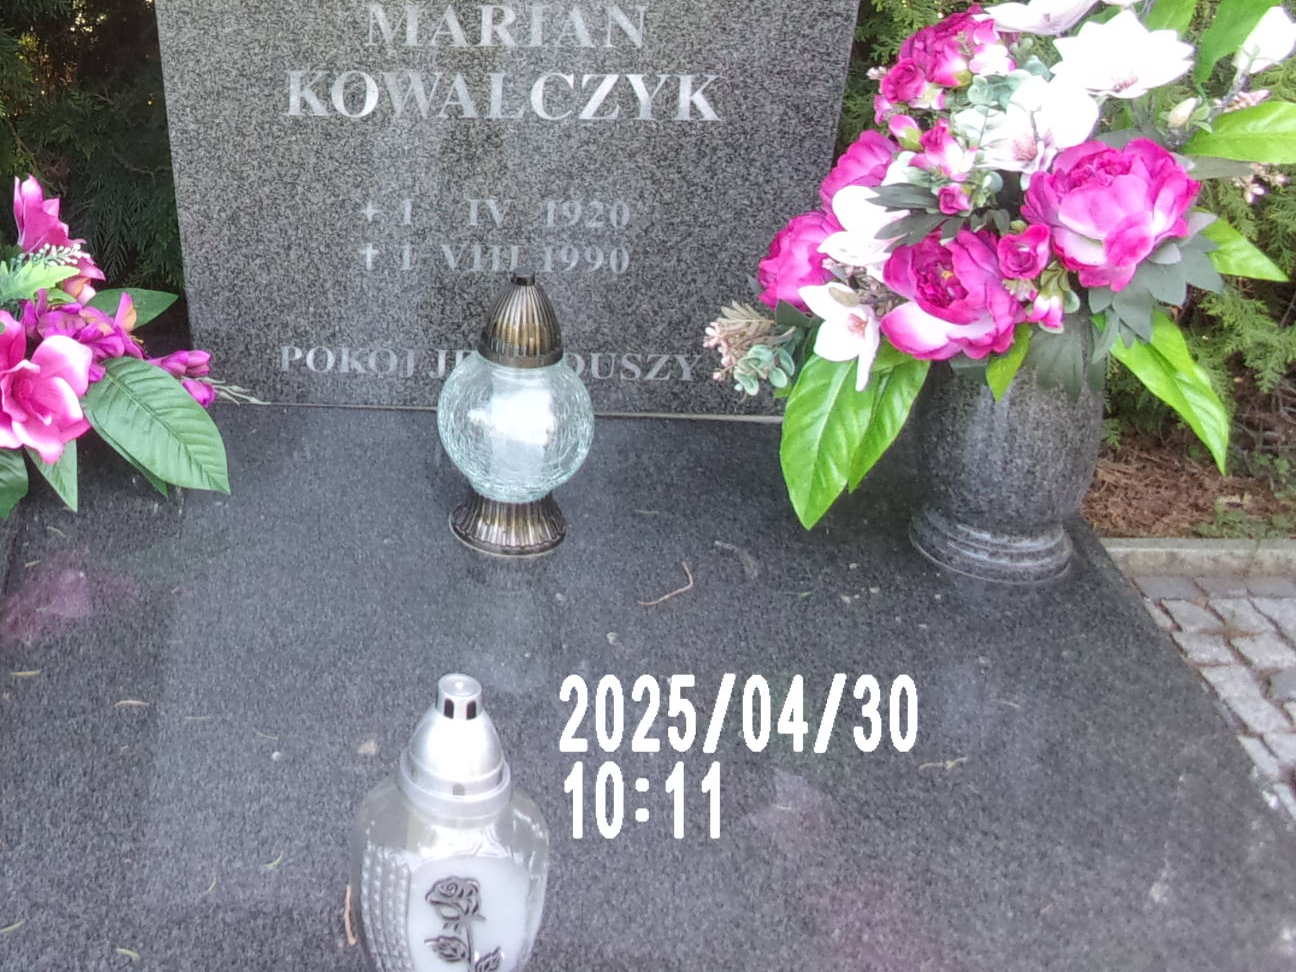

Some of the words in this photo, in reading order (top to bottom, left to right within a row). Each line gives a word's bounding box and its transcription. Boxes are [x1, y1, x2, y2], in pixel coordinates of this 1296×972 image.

[365, 4, 649, 49] MARIAN
[284, 69, 722, 123] KOWALCZYK
[464, 197, 512, 228] IV
[544, 199, 631, 229] 1920
[439, 243, 521, 273] VIII
[541, 244, 631, 275] 1990
